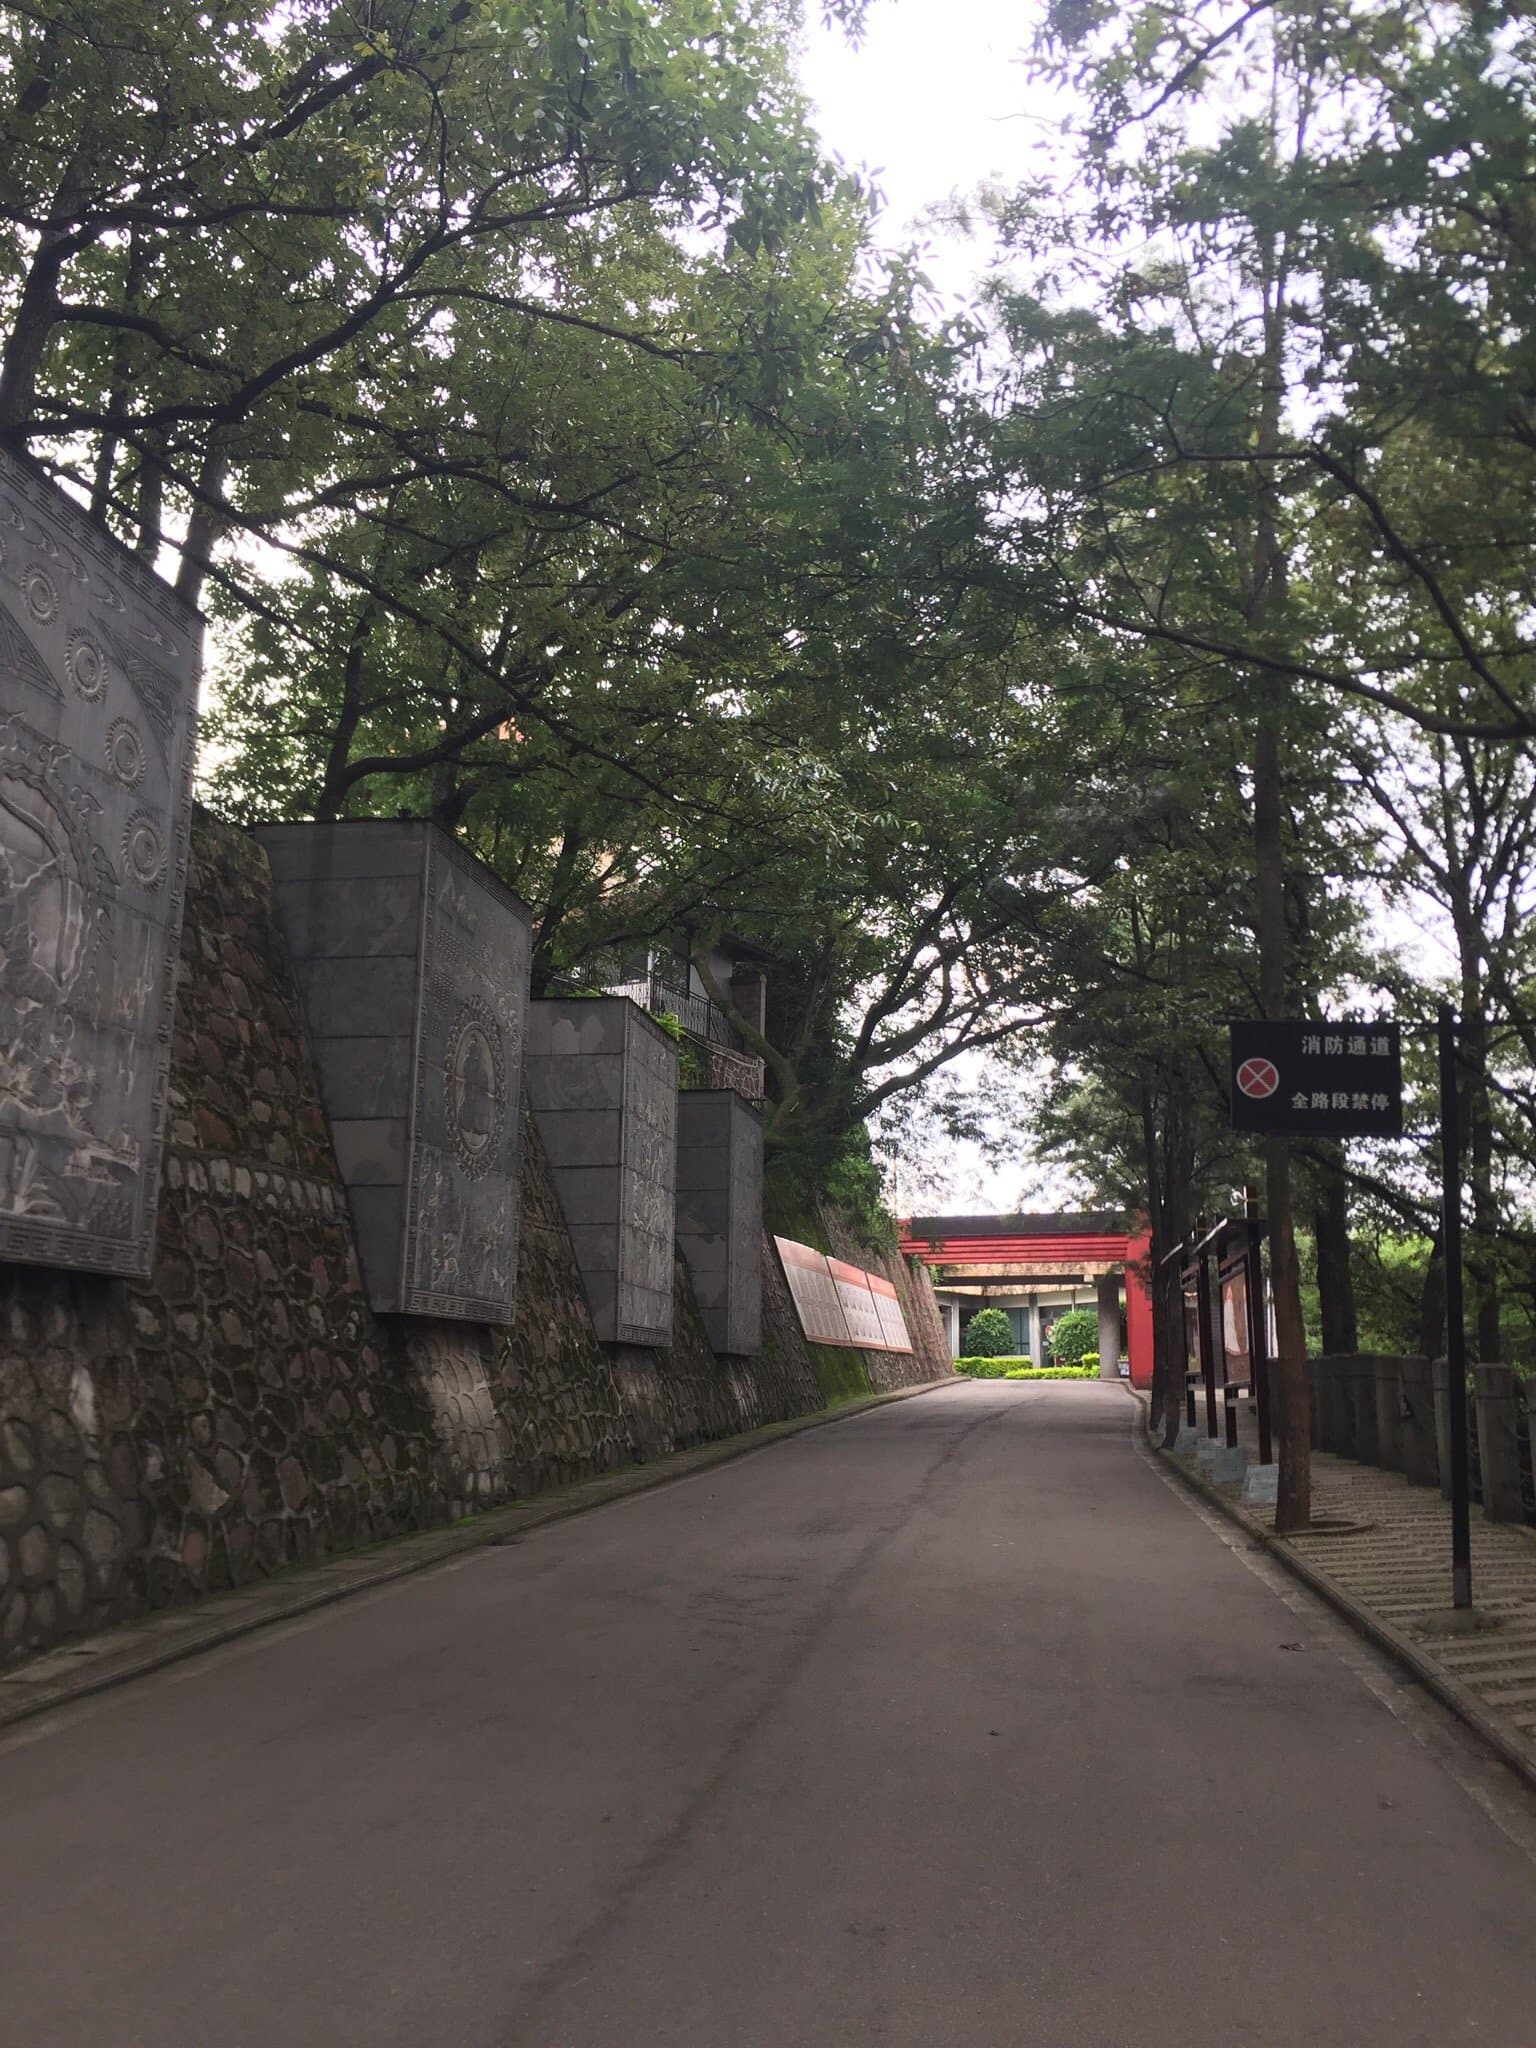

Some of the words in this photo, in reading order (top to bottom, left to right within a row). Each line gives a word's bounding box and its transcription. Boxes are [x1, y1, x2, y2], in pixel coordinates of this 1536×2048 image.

[1301, 1035, 1391, 1056] 消防通道
[1291, 1092, 1390, 1111] 全路段禁停
